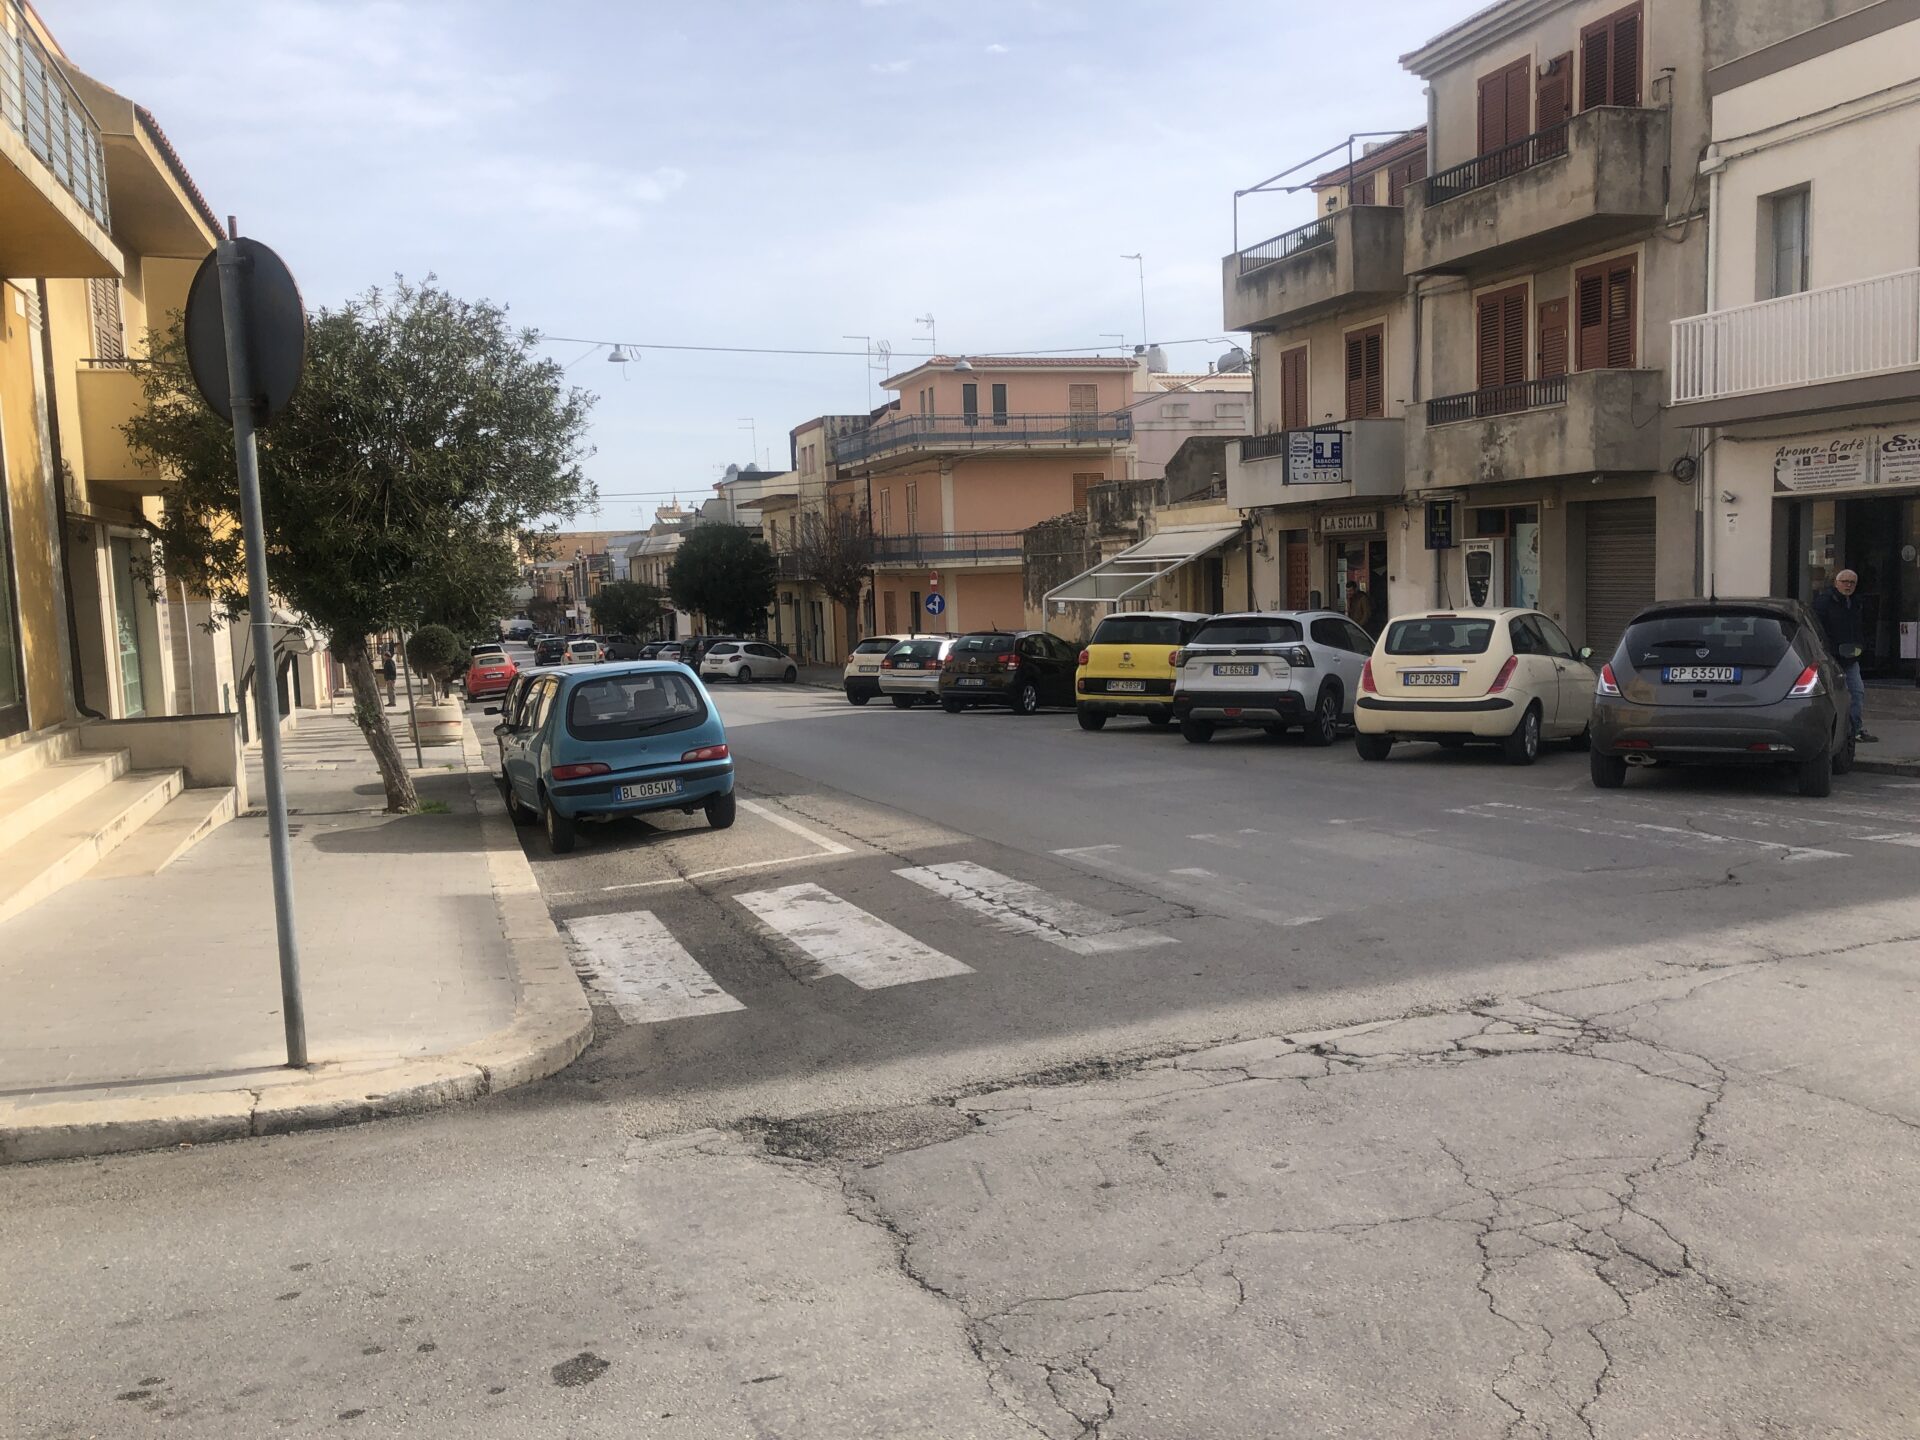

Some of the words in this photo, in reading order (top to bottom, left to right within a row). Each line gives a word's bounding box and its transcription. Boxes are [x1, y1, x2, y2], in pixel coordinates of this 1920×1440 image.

[1314, 433, 1340, 458] T
[1892, 434, 1920, 446] Sv
[1775, 446, 1819, 457] Aroma
[1293, 470, 1340, 481] LOTTO
[1324, 518, 1336, 530] LA
[1338, 514, 1373, 529] SICILIA
[1409, 674, 1421, 684] CP
[1423, 674, 1453, 684] 029SR
[1671, 667, 1687, 679] GP
[1691, 667, 1732, 679] 635VD
[622, 786, 637, 799] BL
[639, 780, 675, 796] 085WK
